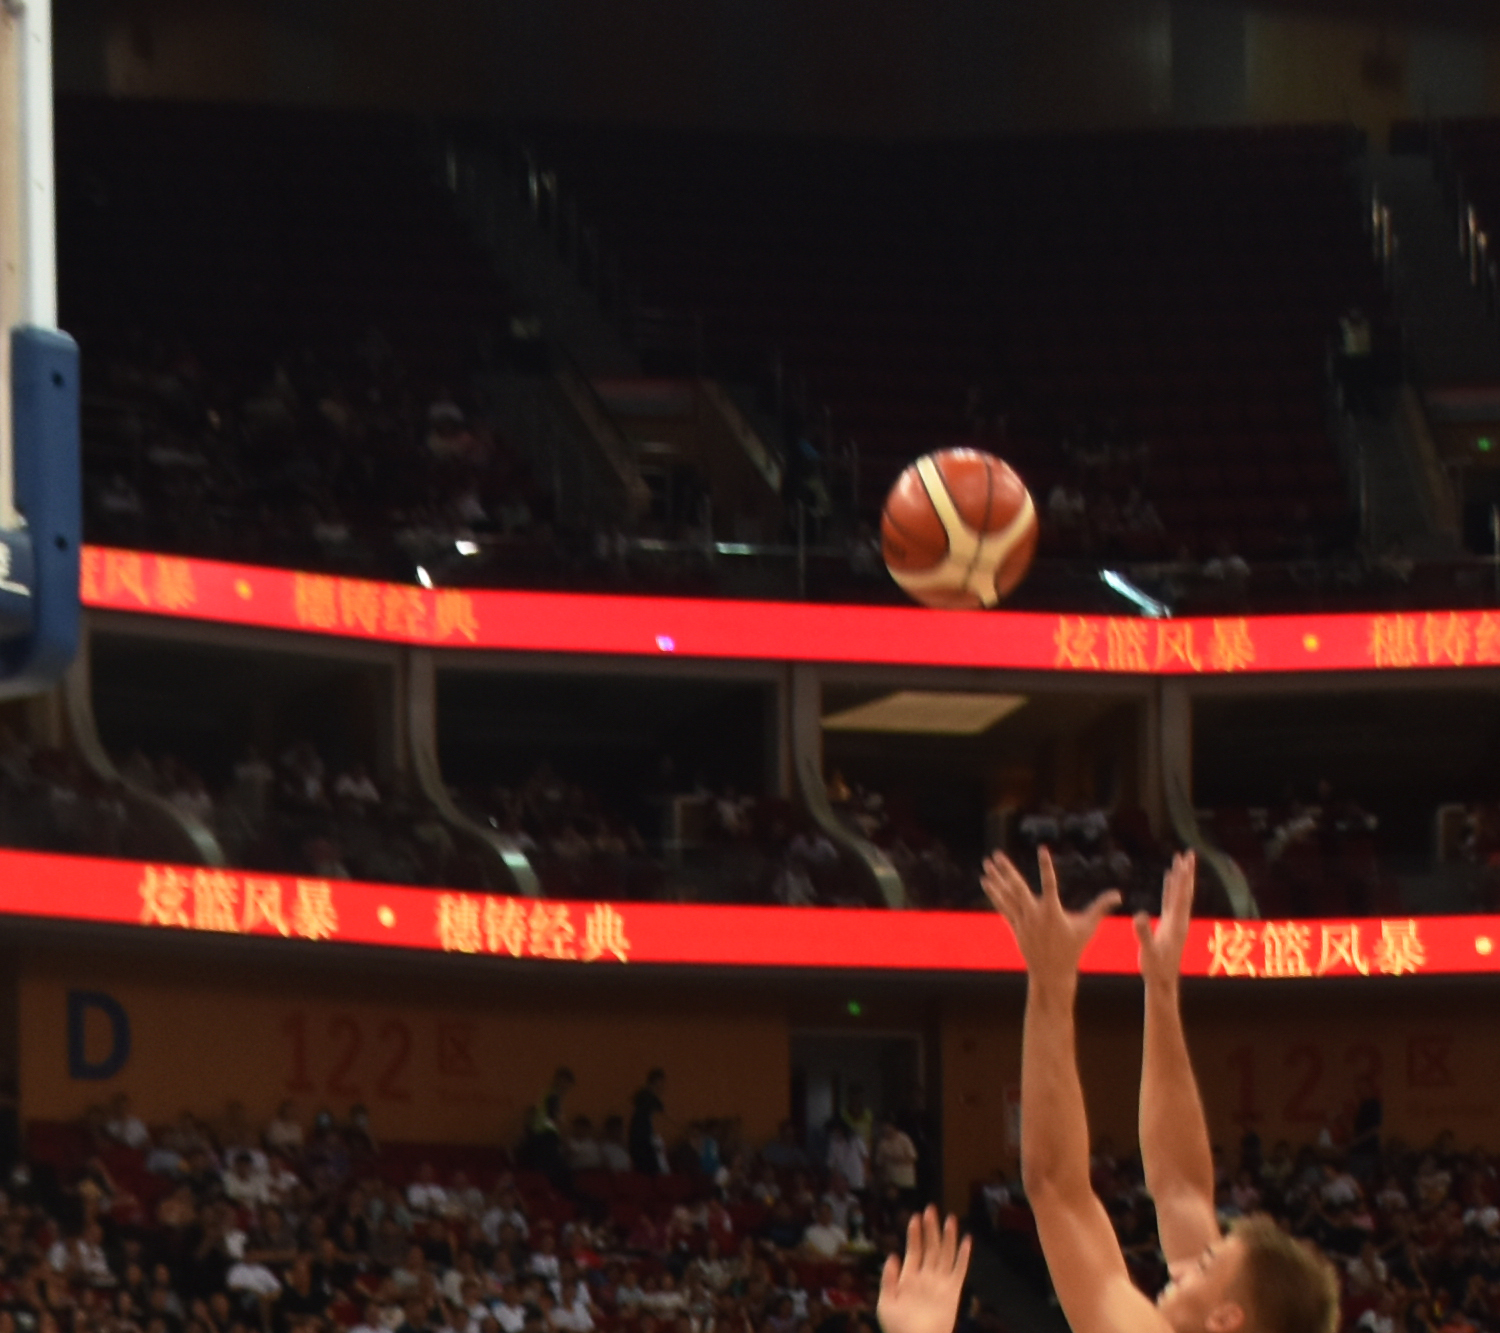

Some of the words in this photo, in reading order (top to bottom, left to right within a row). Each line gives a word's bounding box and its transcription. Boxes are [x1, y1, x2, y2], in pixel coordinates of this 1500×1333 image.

[1052, 612, 1256, 674] 炫篮风暴
[136, 862, 342, 942] 炫篮风暴
[434, 890, 634, 966] 穗铸经典
[1207, 918, 1430, 980] 炫篮风暴
[66, 989, 132, 1082] D
